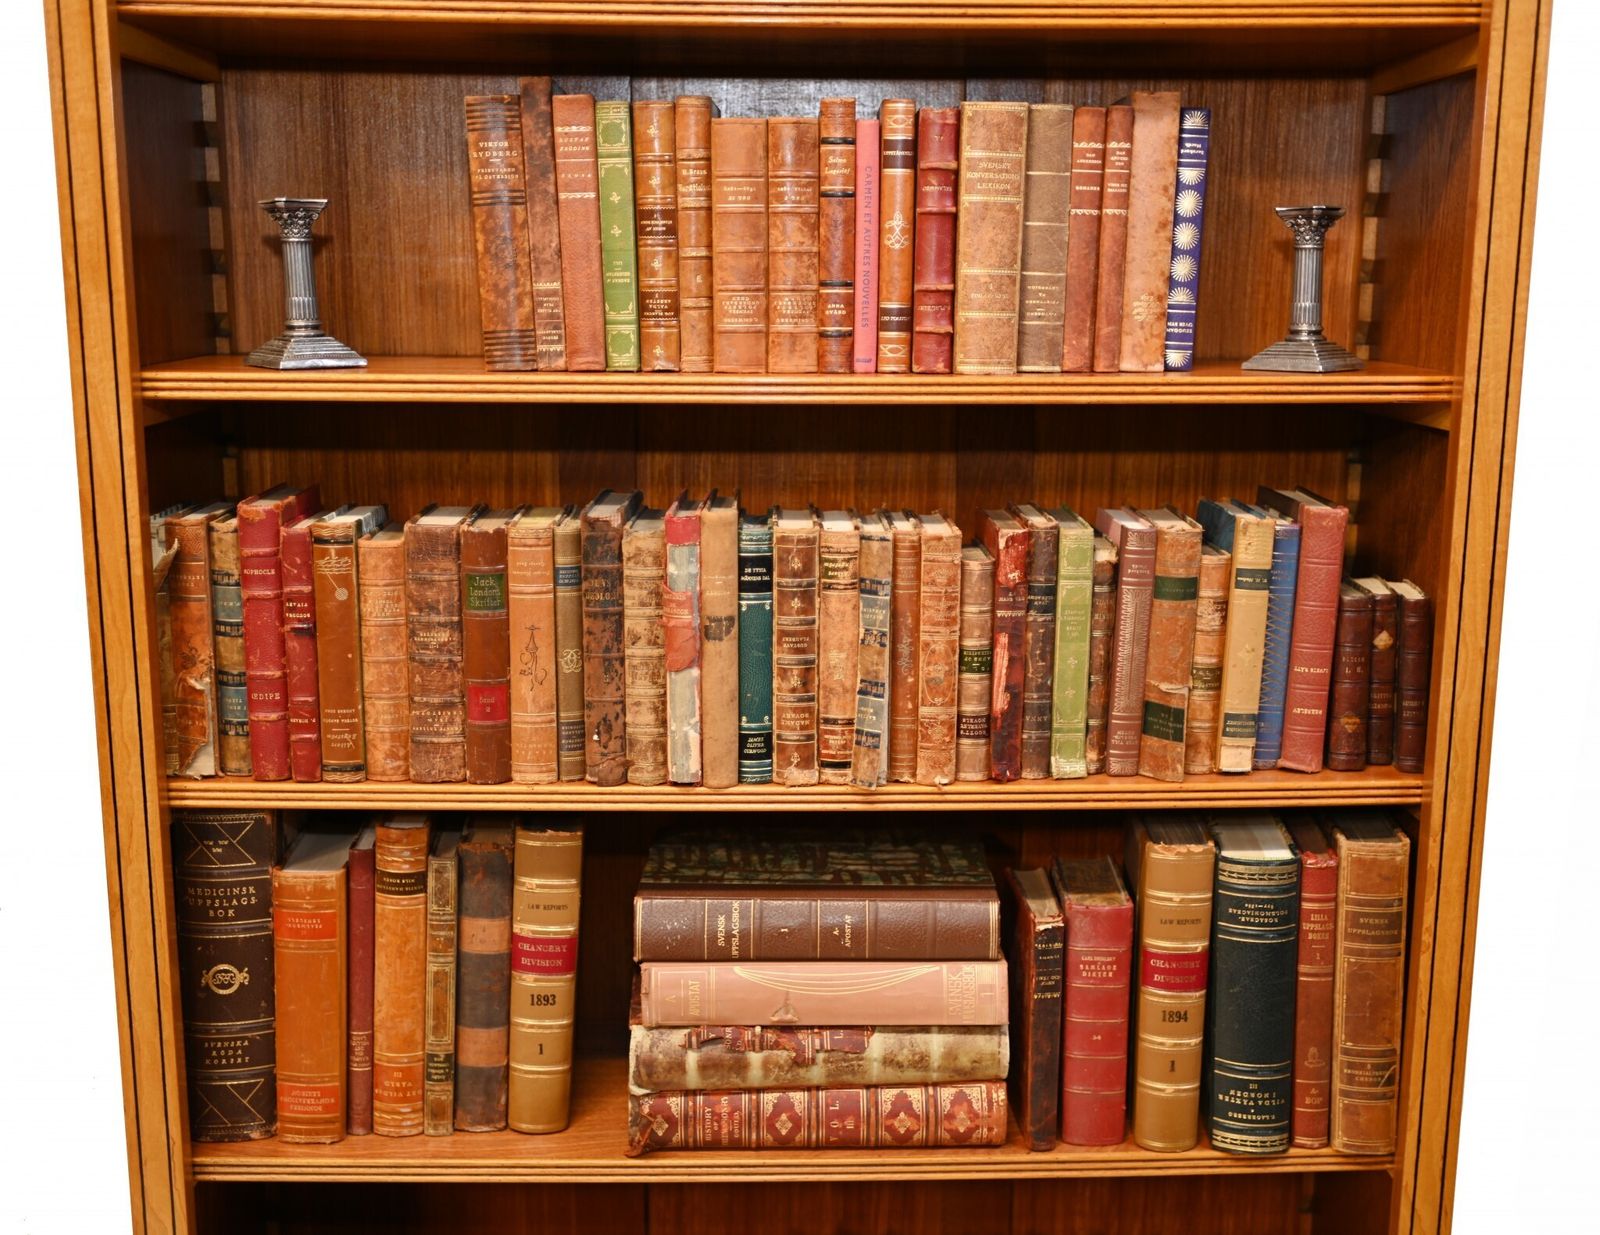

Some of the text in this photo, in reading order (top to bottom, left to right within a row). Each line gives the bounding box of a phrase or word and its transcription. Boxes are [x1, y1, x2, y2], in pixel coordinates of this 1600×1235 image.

[478, 141, 509, 149] VIKTOR
[472, 149, 519, 158] RYDBERG
[827, 156, 847, 164] Selma
[861, 165, 873, 329] CARMEN ET AUTRES NOUVELLES
[243, 568, 276, 576] SOPHOCLE
[473, 576, 496, 587] Jack
[470, 587, 500, 597] Londons
[470, 597, 501, 608] Skrifter
[251, 692, 281, 701] ŒDIPE
[187, 885, 256, 897] MEDICINSK
[187, 896, 258, 907] UPPSLAGS-
[209, 909, 236, 918] BOK
[1310, 913, 1329, 921] LILLA
[1359, 917, 1389, 925] SVENSK
[717, 914, 726, 947] SVENSK
[731, 900, 741, 959] UPPSLAGSBOK
[843, 914, 851, 947] APOSTAT
[1347, 927, 1399, 937] UPPSLAGSBOK
[1307, 931, 1330, 940] BOKEN
[518, 942, 568, 953] CHANCERY
[521, 957, 563, 967] DIVISION
[1150, 959, 1201, 969] CHANCERY
[1153, 974, 1197, 983] DIVISION
[689, 979, 700, 1017] APOSTAT
[948, 971, 962, 1017] SVENSK
[962, 964, 976, 1024] UPPSLAGSBOK
[529, 993, 557, 1006] 1893
[1160, 1010, 1189, 1023] 1894
[204, 1039, 249, 1048] SVENSKA
[538, 1043, 544, 1055] 1
[205, 1056, 250, 1065] KORSET
[1169, 1060, 1176, 1072] 1
[1229, 1089, 1270, 1099] NORDEN
[1257, 1098, 1285, 1106] VILDA
[704, 1106, 712, 1141] HISTORY
